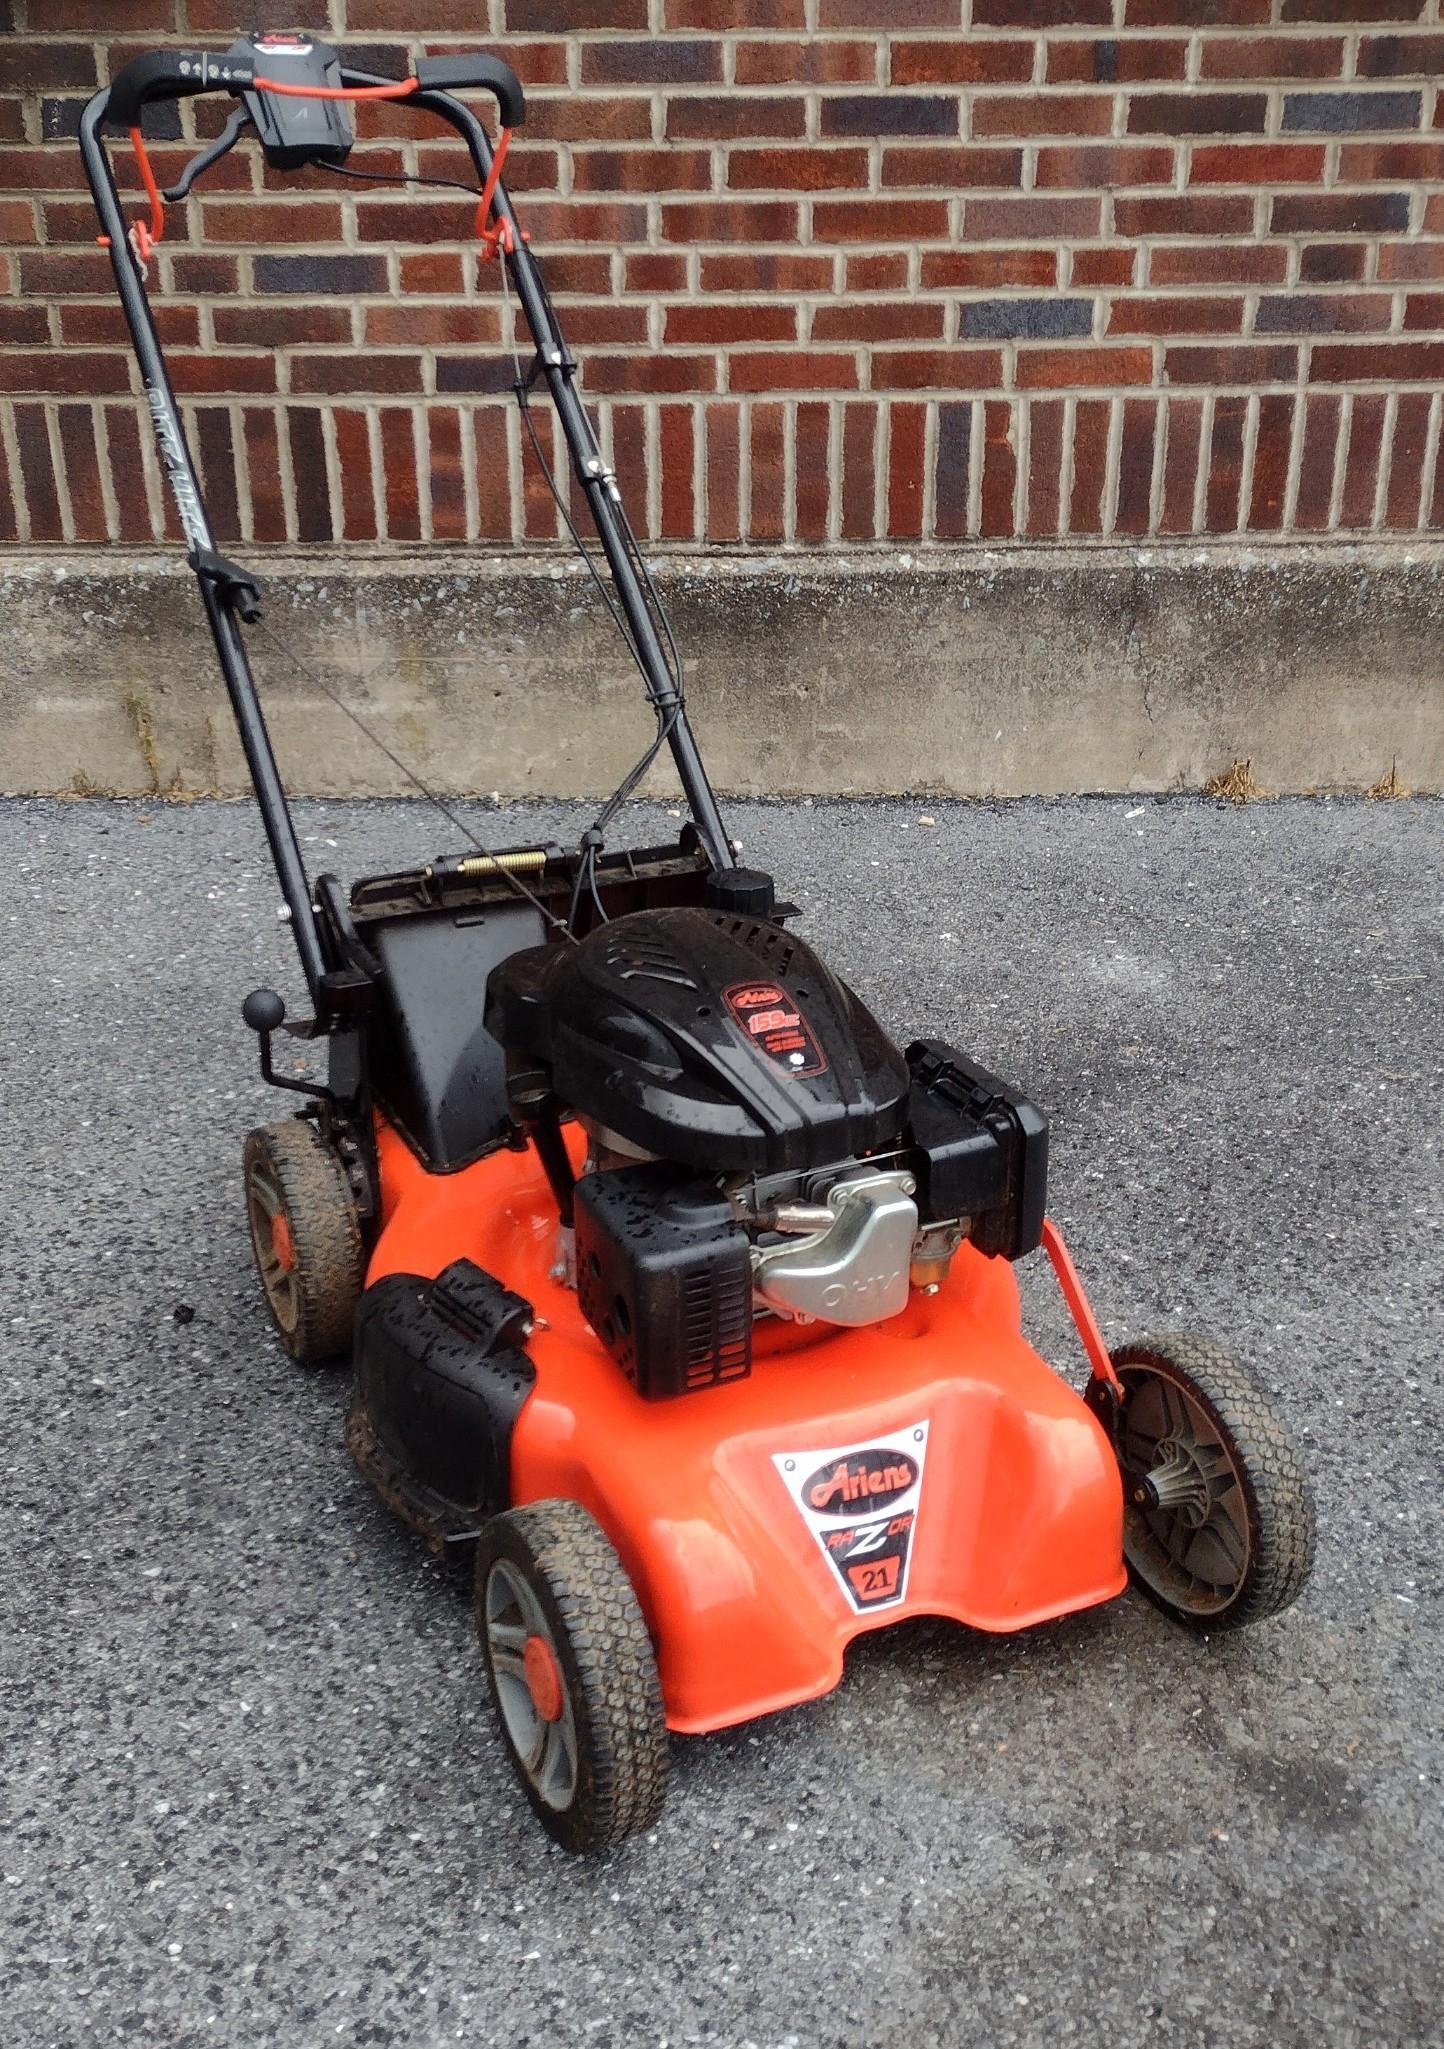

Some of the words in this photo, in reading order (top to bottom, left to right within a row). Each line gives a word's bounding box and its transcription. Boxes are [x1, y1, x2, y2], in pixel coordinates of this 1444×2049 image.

[810, 1462, 912, 1508] Ariens
[826, 1516, 913, 1558] RAZOR
[861, 1567, 892, 1593] 21
